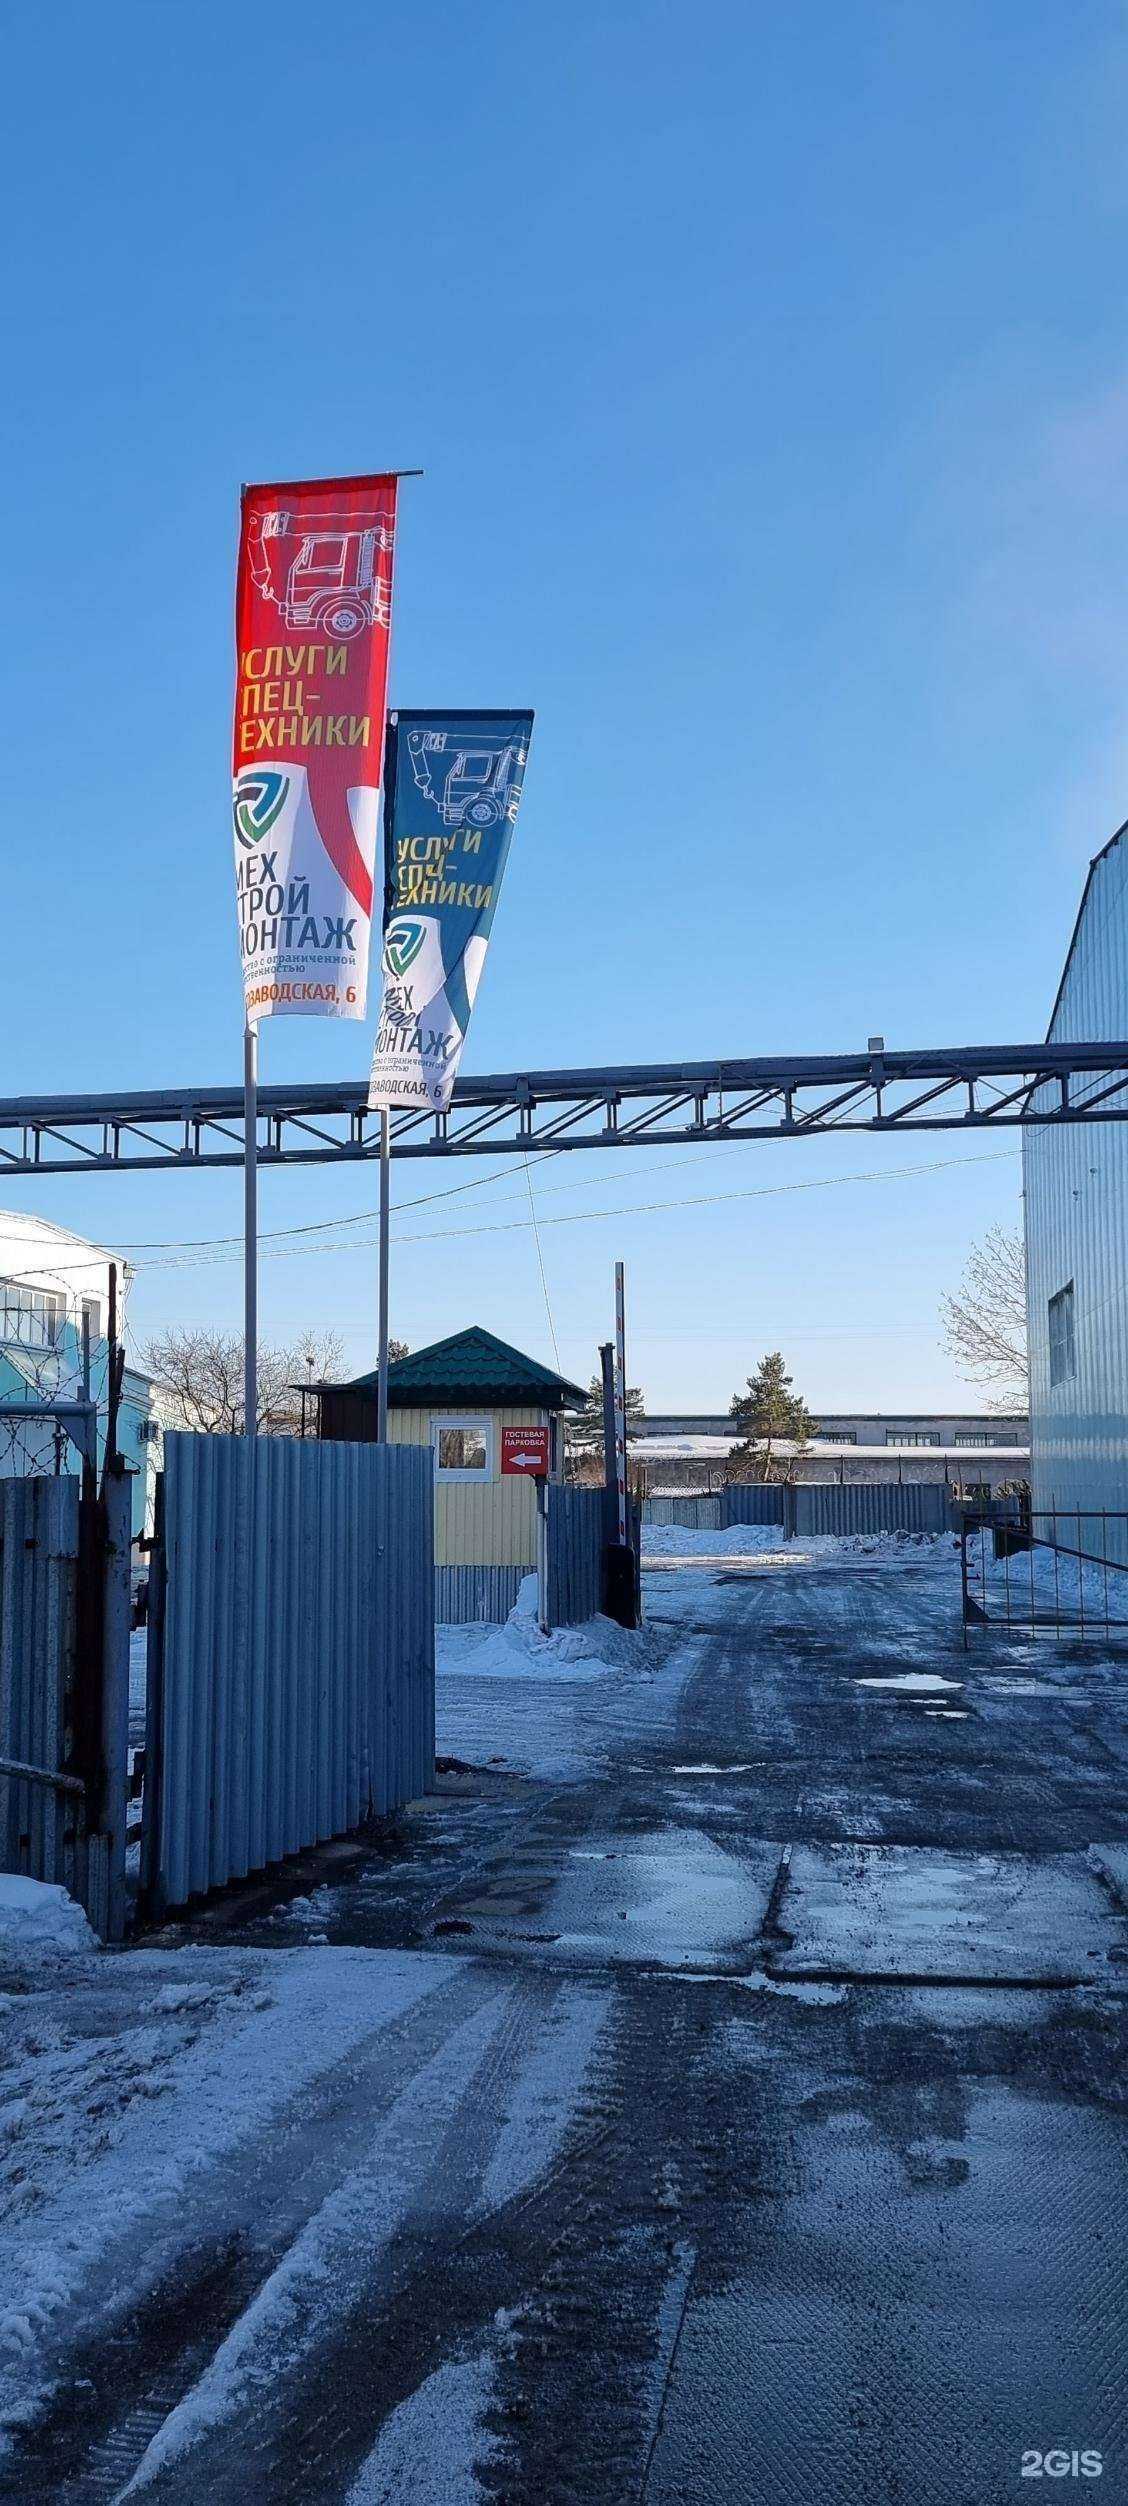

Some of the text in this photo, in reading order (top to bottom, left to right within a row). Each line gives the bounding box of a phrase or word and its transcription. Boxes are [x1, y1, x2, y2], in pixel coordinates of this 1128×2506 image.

[242, 644, 348, 679] СЛУГИ
[242, 680, 321, 719] ПЕЦ-
[241, 714, 371, 753] ЕХНИКИ
[238, 875, 310, 925] ТРОЙ
[266, 954, 356, 966] ограниченной
[245, 982, 357, 1008] ЗАВОДСКАЯ, 6
[433, 1085, 444, 1098] 6
